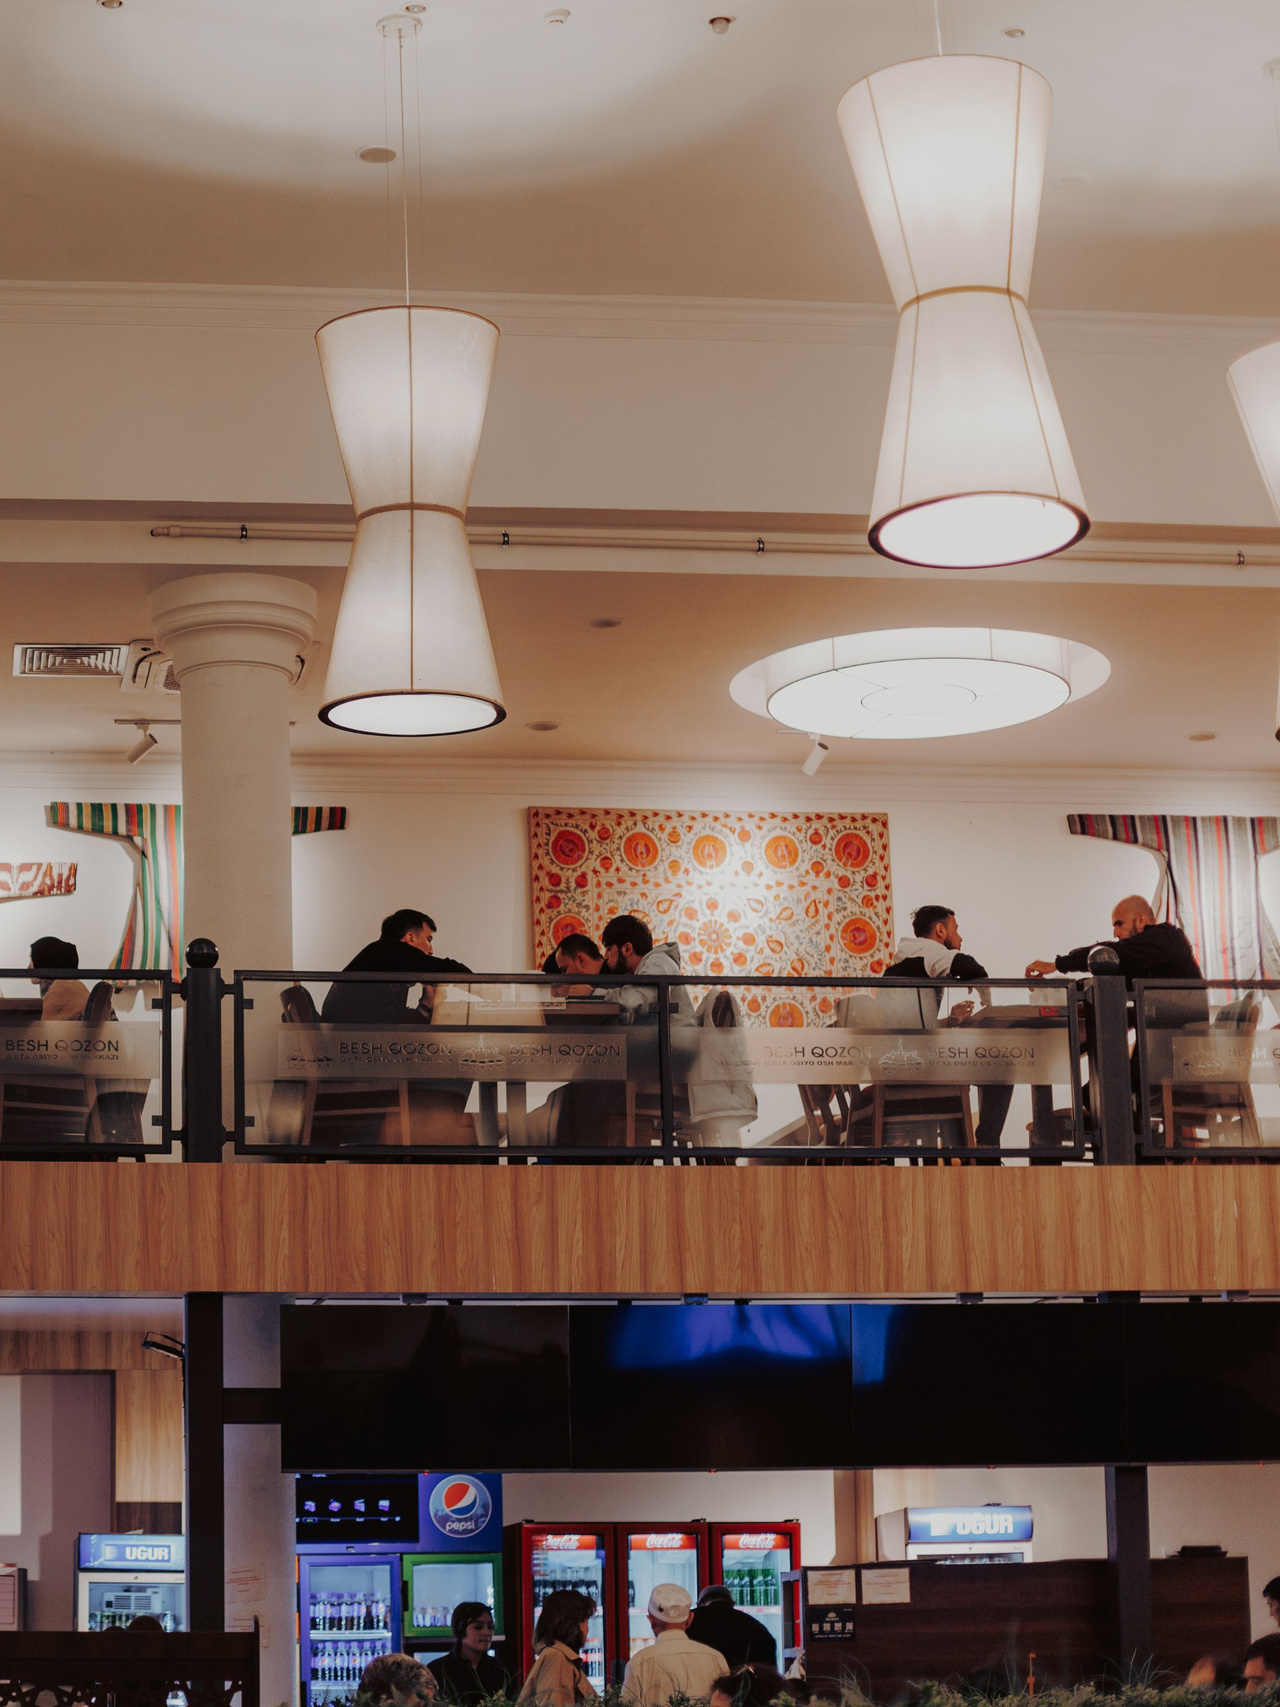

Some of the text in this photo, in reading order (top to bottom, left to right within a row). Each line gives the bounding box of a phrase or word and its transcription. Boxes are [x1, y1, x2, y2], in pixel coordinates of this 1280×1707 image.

[5, 1039, 119, 1053] BESH QOZON
[339, 1042, 452, 1056] BESH QOZON
[509, 1044, 620, 1057] BESH QOZON
[810, 1046, 872, 1059] QOZON
[928, 1046, 1035, 1059] BESH QOZON
[445, 1520, 476, 1532] pepsi
